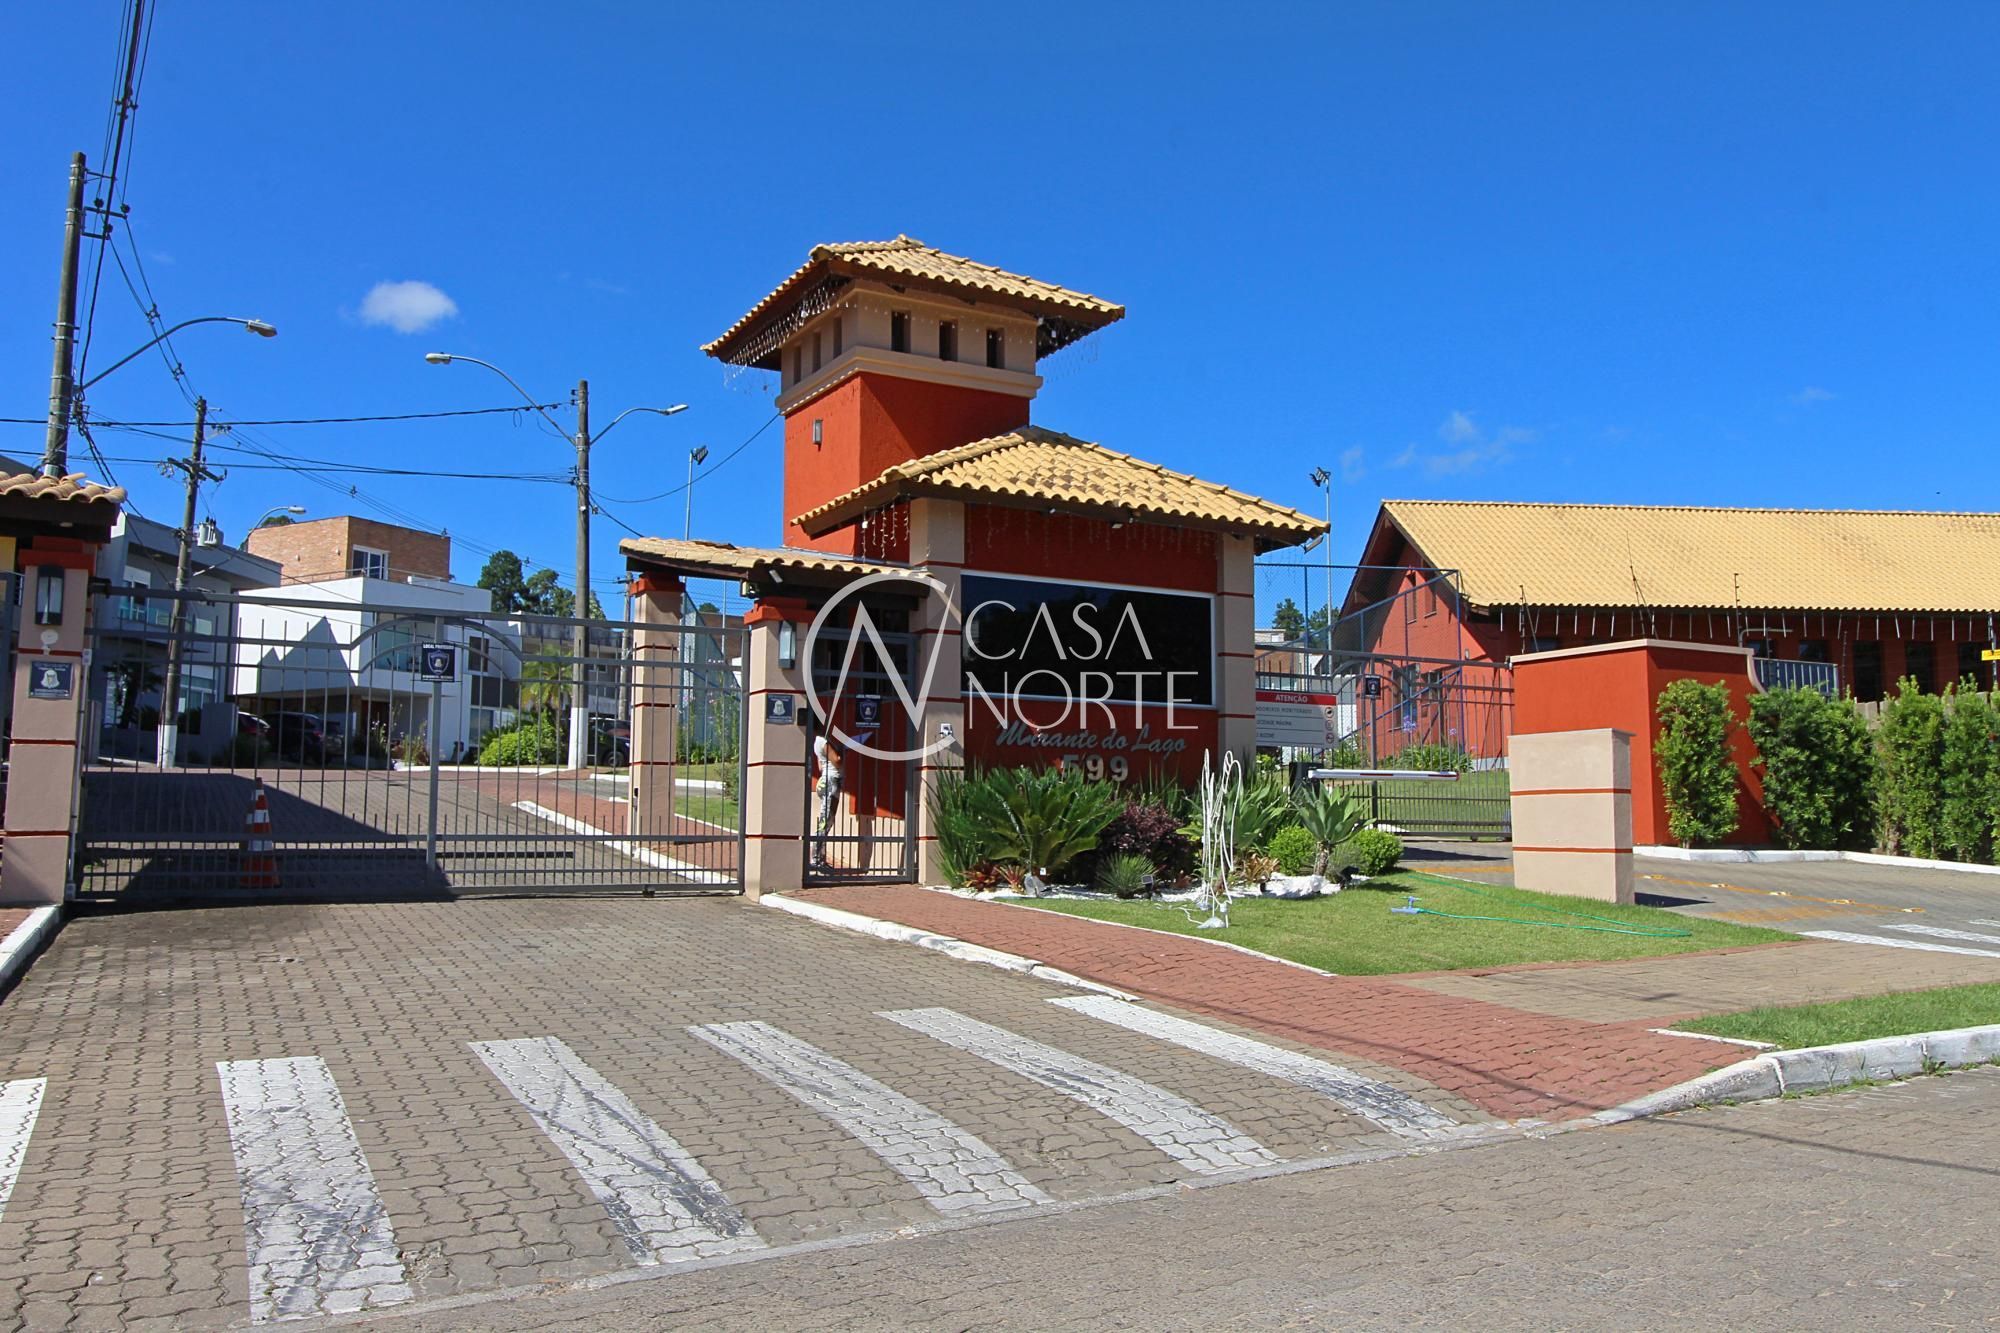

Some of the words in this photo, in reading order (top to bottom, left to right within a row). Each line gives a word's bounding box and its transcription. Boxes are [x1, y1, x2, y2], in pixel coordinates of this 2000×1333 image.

[996, 720, 1098, 748] Mirante
[1102, 729, 1128, 749] do
[1130, 723, 1187, 760] Lago
[1061, 754, 1129, 782] 599
